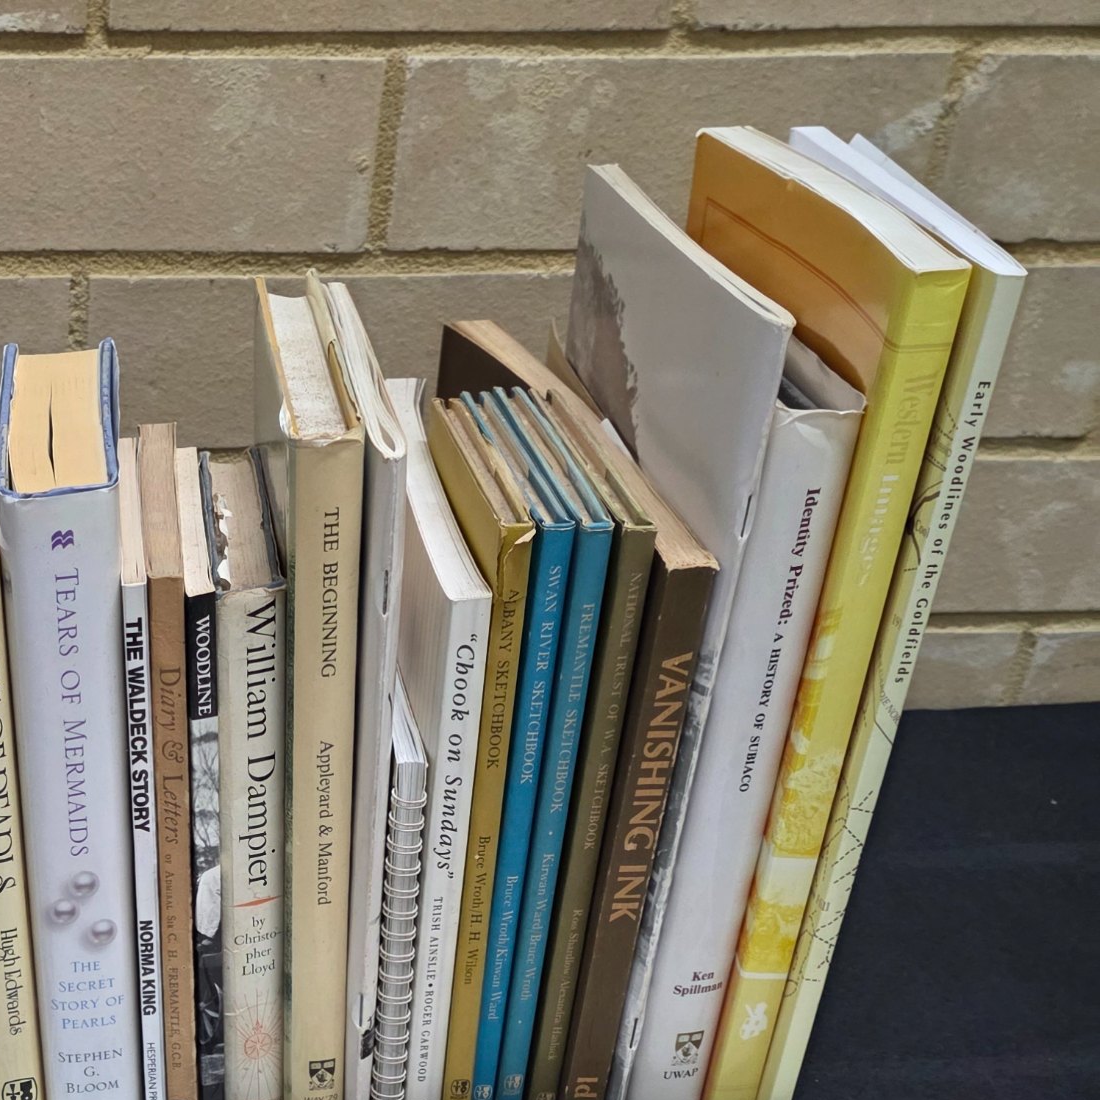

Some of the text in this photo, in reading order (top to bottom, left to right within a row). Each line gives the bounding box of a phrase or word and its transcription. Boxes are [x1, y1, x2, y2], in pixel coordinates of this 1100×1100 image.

[885, 368, 943, 466] Western
[963, 381, 991, 427] Early
[939, 436, 973, 530] Woodlines
[931, 536, 944, 556] of
[321, 506, 340, 679] THE BEGINNING
[921, 563, 938, 590] the
[195, 614, 212, 717] WOODLINE
[739, 487, 821, 793] Identity Prized: A HISTORY OF SUBIACO
[894, 597, 929, 685] Goldfields
[487, 589, 520, 769] ALBANY SKETCHBOOK
[520, 565, 561, 784] SWAN RIVER SKETCHBOOK
[54, 567, 90, 857] TEARS OF MERMAIDS
[125, 617, 150, 832] THE WALDECK STORY
[550, 603, 595, 814] FREMANTLE SKETCHBOOK
[158, 667, 184, 845] Diary & Letters
[239, 598, 276, 887] William Dampier
[447, 733, 463, 763] on
[608, 650, 693, 922] VANISHING INK
[316, 740, 335, 906] Appleyard & Manford
[251, 917, 266, 930] by
[70, 961, 100, 973] THE
[139, 920, 157, 1016] NORMA KING
[242, 961, 276, 977] Lloyd
[245, 948, 272, 964] pher
[692, 971, 715, 982] Ken
[3, 968, 27, 1036] Edwards
[50, 995, 125, 1011] STORY OF
[59, 977, 116, 993] SECRET
[417, 897, 443, 1082] TRISH AINSLIE ROGER GARWOOD
[673, 981, 723, 997] Spillman
[61, 1015, 117, 1030] PEARLS
[57, 1048, 123, 1063] STEPHEN
[83, 1066, 100, 1077] G.
[147, 1042, 157, 1089] HESPERIAN
[663, 1067, 699, 1080] UWAP
[66, 1079, 120, 1094] BLOOM
